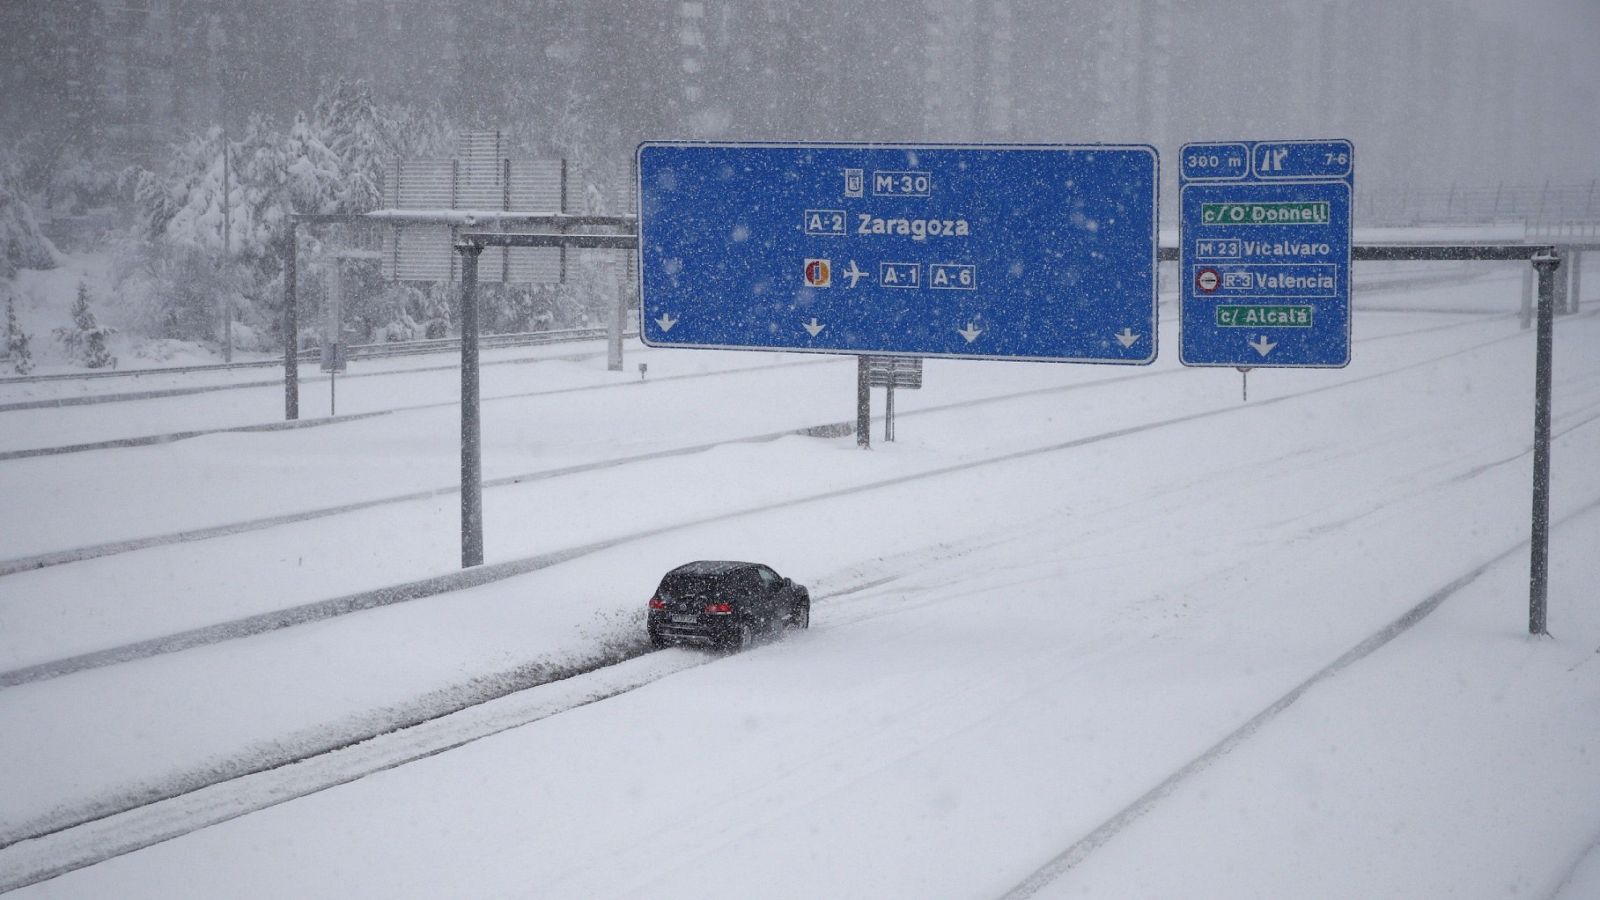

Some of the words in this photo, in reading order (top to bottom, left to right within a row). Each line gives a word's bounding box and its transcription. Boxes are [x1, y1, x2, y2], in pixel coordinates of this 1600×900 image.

[1188, 155, 1219, 168] 300
[1228, 157, 1242, 167] m
[1324, 153, 1348, 166] 7-6
[876, 175, 928, 193] M-30
[809, 213, 843, 231] A-2
[857, 213, 969, 241] Zaragoza
[1243, 241, 1330, 256] Vicalvaro
[884, 267, 918, 284] A-1
[934, 268, 972, 286] A-6
[1225, 275, 1251, 288] R-3
[1256, 273, 1334, 289] Valencia
